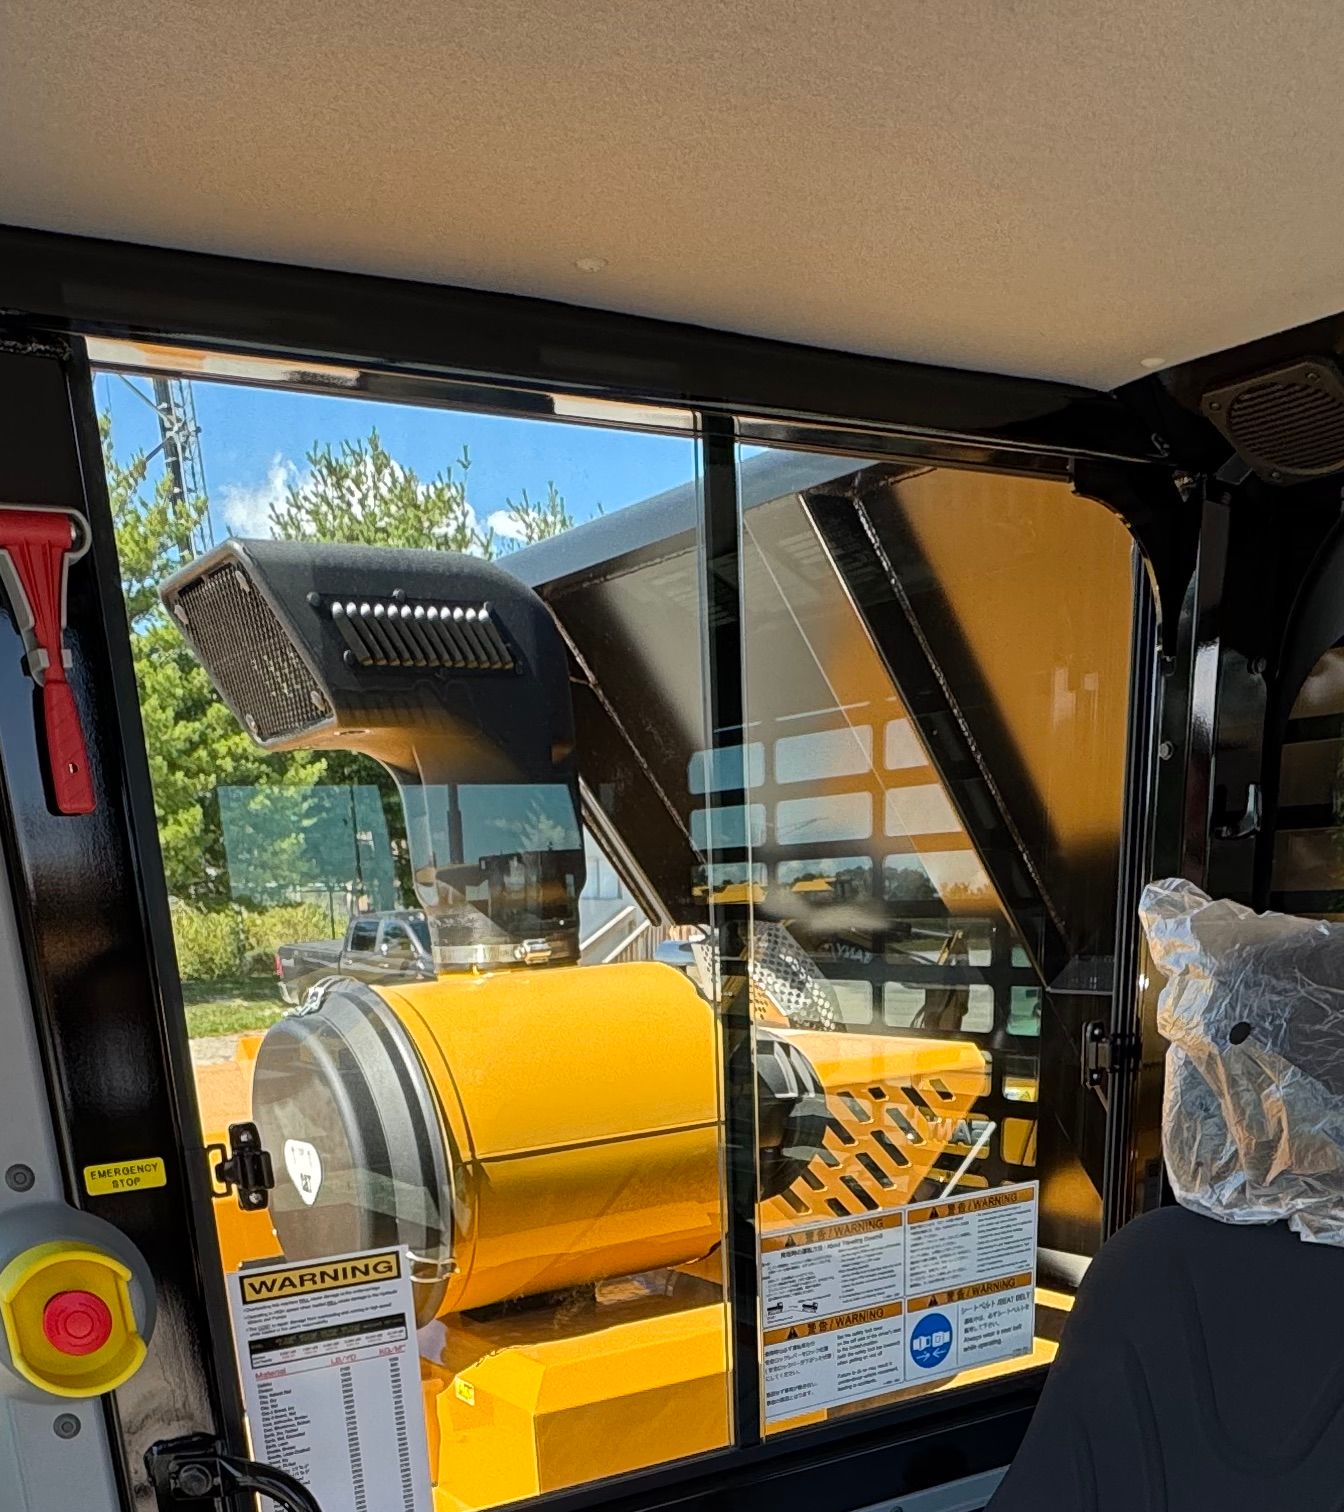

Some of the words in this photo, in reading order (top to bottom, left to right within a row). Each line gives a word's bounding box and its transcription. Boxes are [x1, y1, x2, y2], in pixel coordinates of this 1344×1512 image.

[90, 1162, 158, 1180] EMERGENCY
[112, 1177, 141, 1189] STOP
[974, 1192, 1017, 1209] WARNING
[833, 1218, 883, 1236] WARNING
[247, 1259, 393, 1294] WARNING
[972, 1278, 1015, 1294] WARNING
[835, 1308, 883, 1327] WARNING
